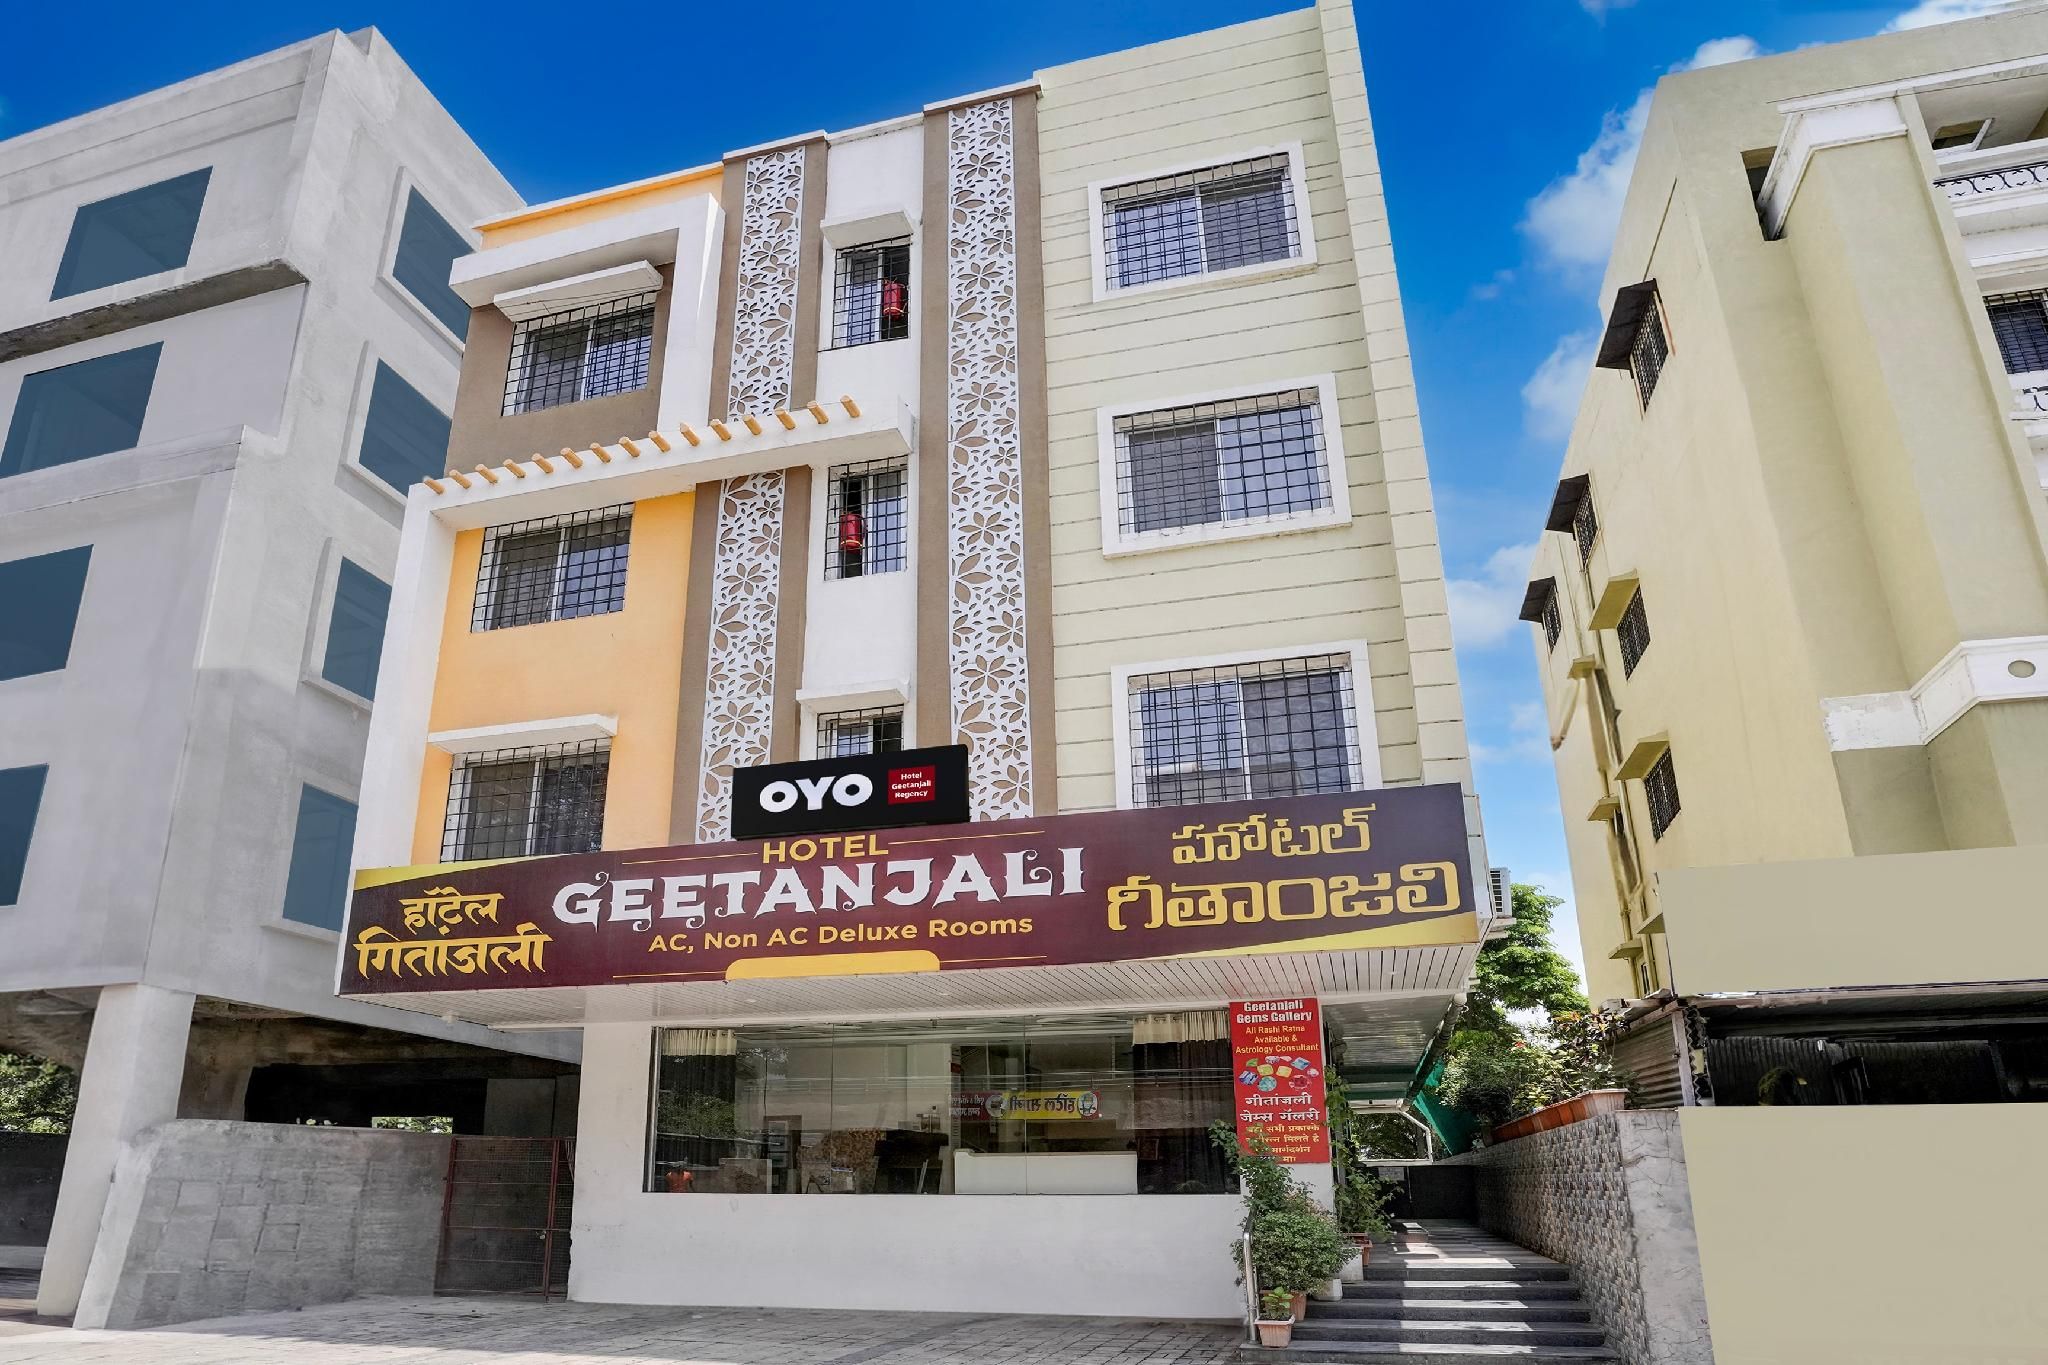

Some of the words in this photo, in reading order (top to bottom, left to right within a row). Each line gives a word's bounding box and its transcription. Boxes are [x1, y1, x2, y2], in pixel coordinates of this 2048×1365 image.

[900, 771, 922, 781] Hotel
[891, 779, 932, 790] Geetanjali
[759, 773, 873, 813] OYO
[894, 790, 929, 799] Regency
[1172, 803, 1376, 865] హోటల్
[763, 835, 889, 864] HOTEL
[551, 847, 1086, 933] GEETANJALI
[1107, 861, 1461, 931] గీతాంజలి
[647, 933, 694, 956] AC,
[704, 931, 758, 951] Non
[765, 926, 808, 947] AC
[818, 919, 918, 945] Deluxe
[929, 916, 1034, 938] Rooms
[1243, 1000, 1303, 1012] Geetanjali
[1236, 1013, 1269, 1024] Gems
[1270, 1011, 1313, 1022] Gallery
[1258, 1026, 1280, 1034] Rashi
[1282, 1025, 1305, 1033] Ratna
[1254, 1036, 1290, 1044] Available
[1291, 1034, 1298, 1042] &
[1235, 1046, 1274, 1054] Astrology
[1275, 1043, 1319, 1052] Consultant
